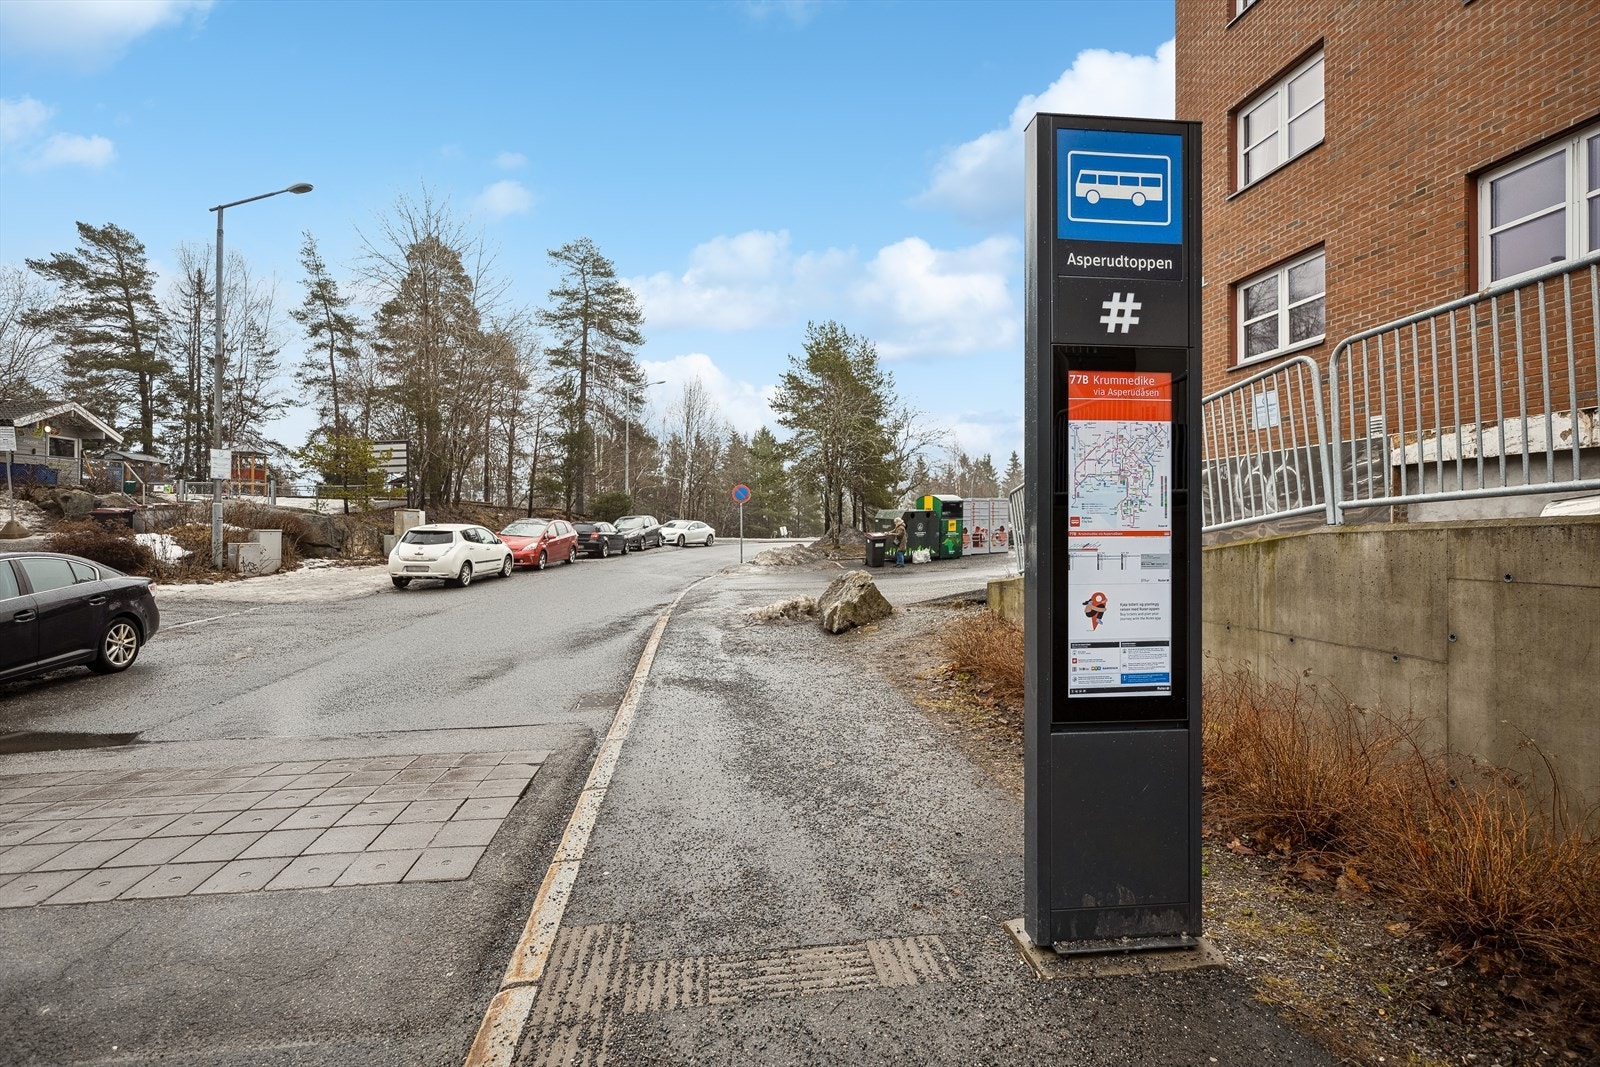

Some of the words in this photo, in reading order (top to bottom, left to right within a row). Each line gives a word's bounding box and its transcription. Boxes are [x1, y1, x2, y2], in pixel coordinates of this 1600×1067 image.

[1067, 252, 1172, 271] Asperudtoppen
[1100, 292, 1142, 334] #
[1070, 374, 1088, 384] 77B
[1093, 376, 1155, 386] Krummedike
[1094, 388, 1105, 396] via
[1108, 388, 1159, 398] Asperudåsen
